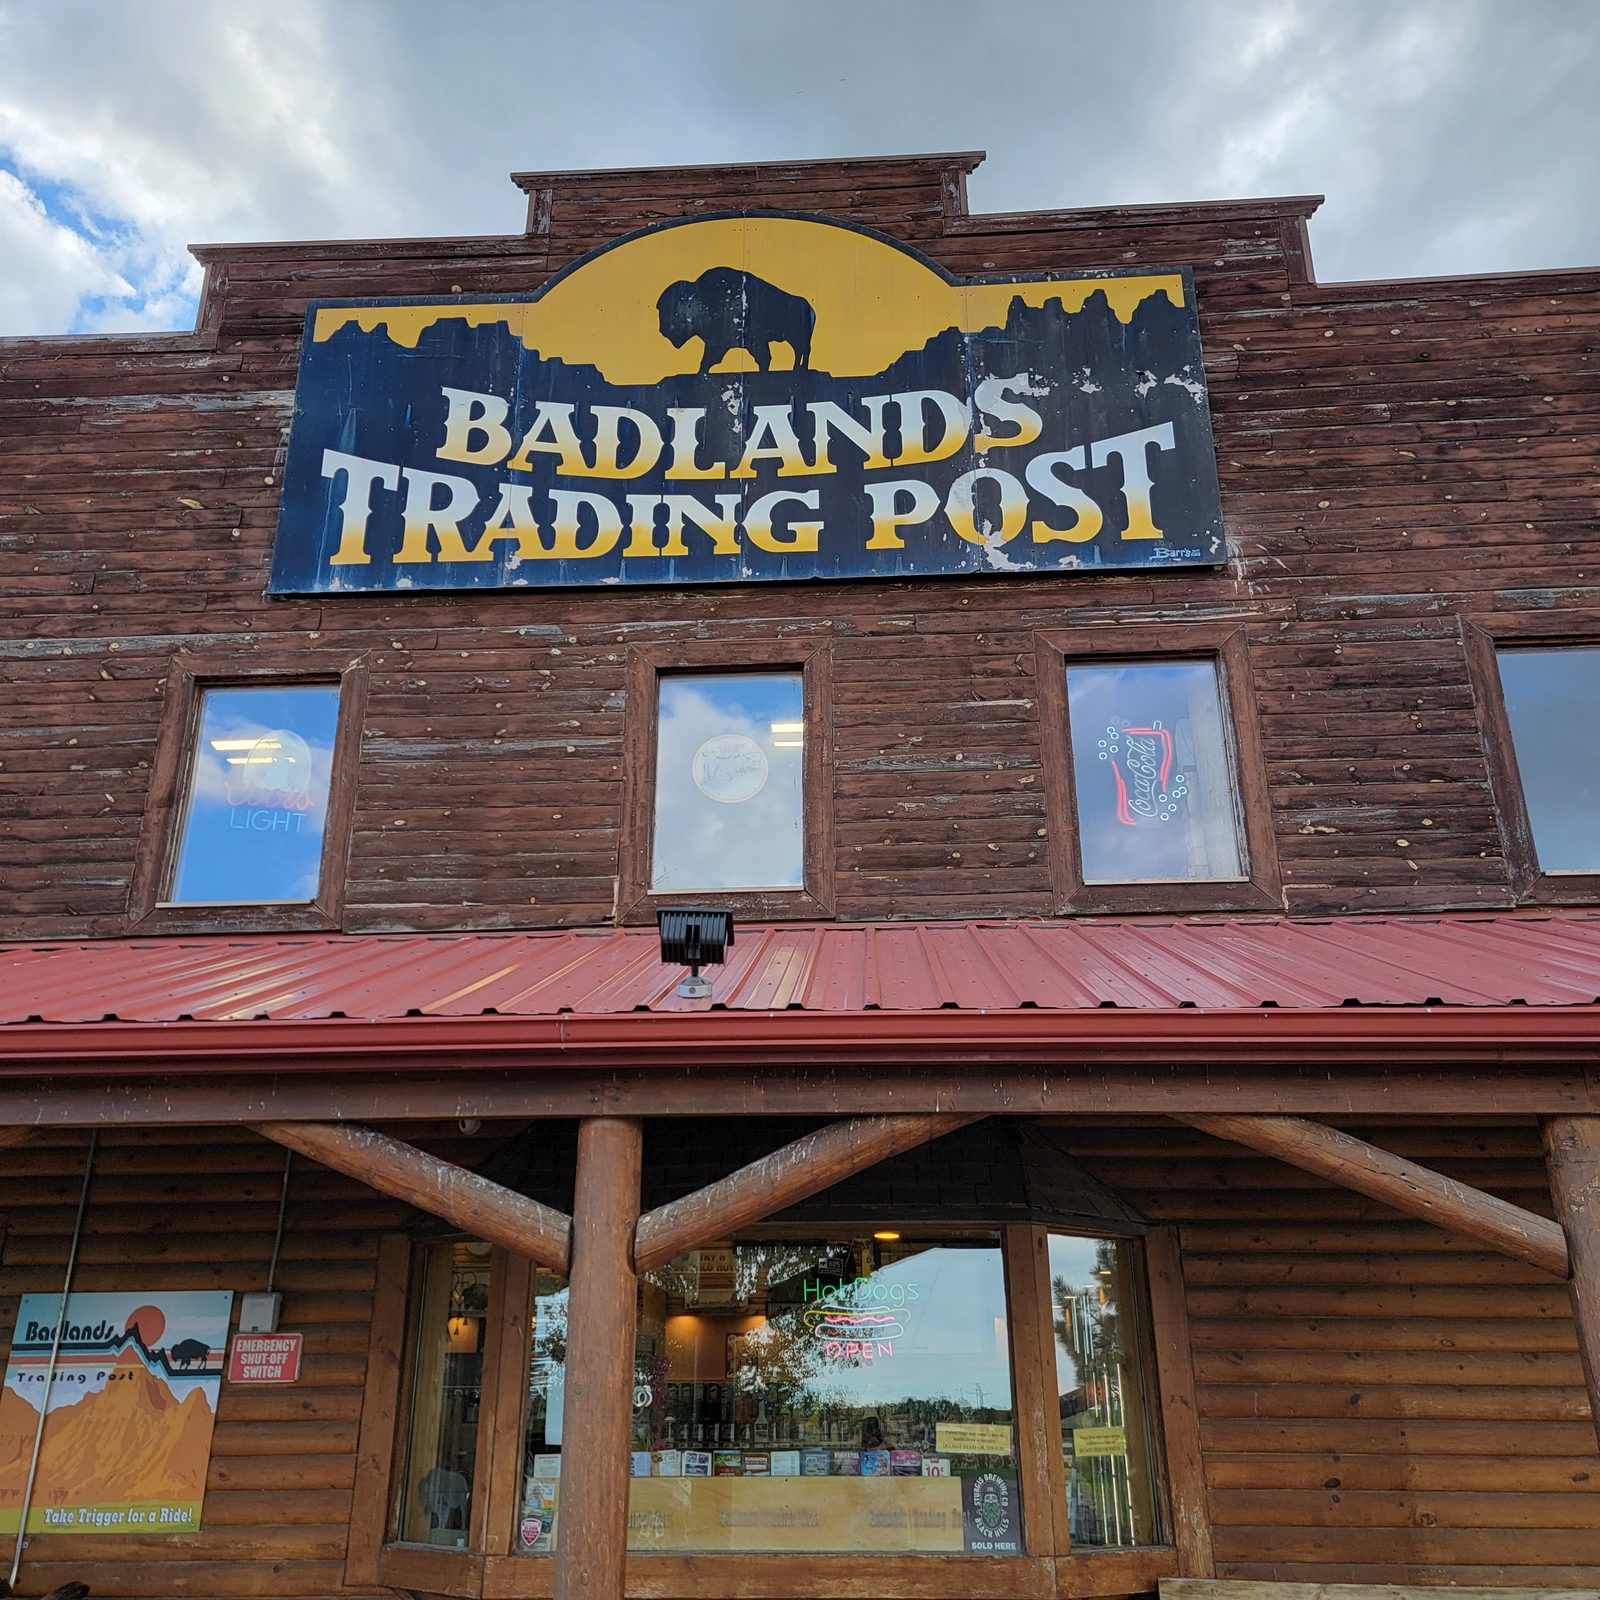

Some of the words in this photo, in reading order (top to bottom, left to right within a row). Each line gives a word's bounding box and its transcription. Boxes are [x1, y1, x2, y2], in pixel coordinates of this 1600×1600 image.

[436, 373, 1043, 480] BADLANDS
[321, 448, 824, 565] TRADING
[864, 421, 1175, 549] POST
[229, 808, 308, 833] LIGHT
[803, 1278, 849, 1302] Hot
[854, 1277, 919, 1307] Dogs
[25, 1320, 115, 1341] Badlands
[236, 1339, 297, 1352] EMERGENCY
[826, 1341, 893, 1358] OPEN
[240, 1353, 289, 1365] SHUT-OFF
[96, 1371, 134, 1381] Post
[242, 1365, 282, 1378] SWITCH
[973, 1476, 985, 1506] STURGIS
[983, 1473, 1008, 1497] BREWING
[1001, 1497, 1009, 1507] CO
[44, 1508, 74, 1524] Take
[79, 1508, 125, 1526] Trigger
[127, 1508, 146, 1523] for
[149, 1510, 158, 1523] a
[160, 1507, 193, 1523] Ride!
[974, 1517, 993, 1538] BLACK
[994, 1518, 1010, 1538] HILLS
[971, 1541, 993, 1550] SOLD
[994, 1542, 1016, 1550] HERE
